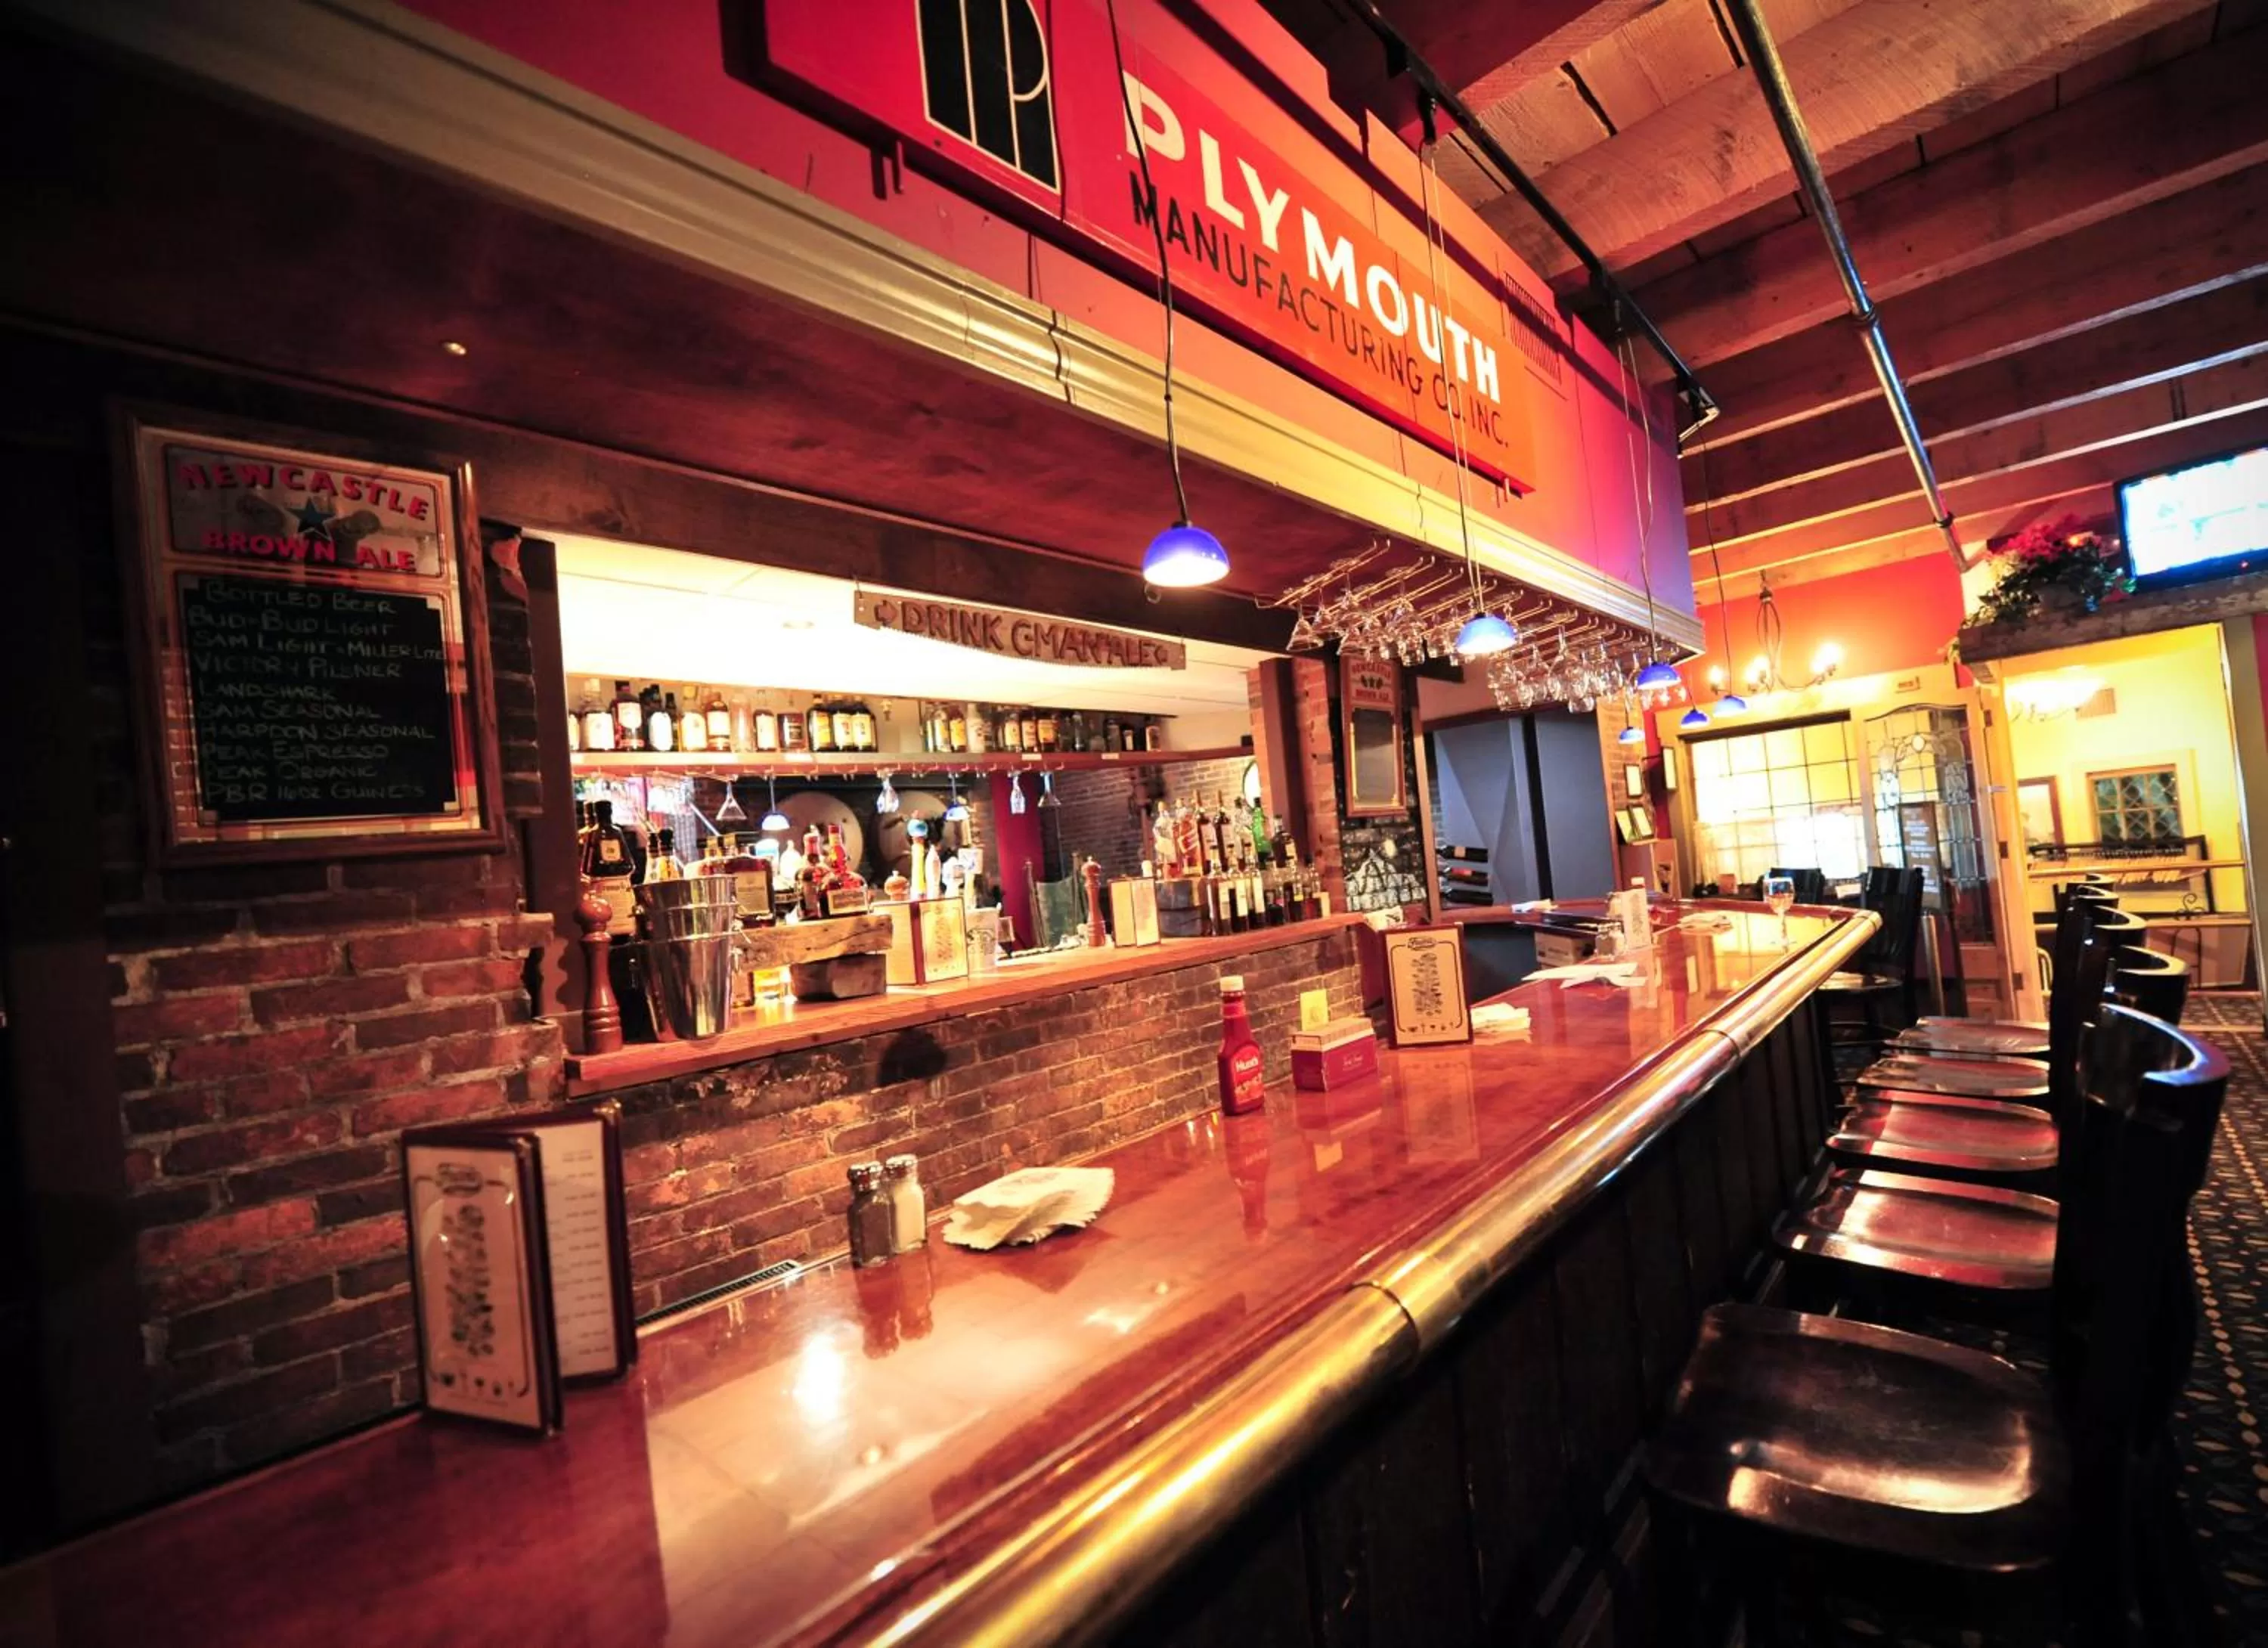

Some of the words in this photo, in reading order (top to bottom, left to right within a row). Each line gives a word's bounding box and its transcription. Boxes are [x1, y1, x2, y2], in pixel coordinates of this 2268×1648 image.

[1122, 70, 1500, 404] PLYMOUTH
[1129, 171, 1424, 395] MANUFACTURING
[1469, 395, 1508, 448] INC.
[177, 464, 429, 522] NEWCASTLE
[201, 529, 337, 562] BROWN
[355, 545, 417, 572] ALE
[900, 600, 1005, 652] DRINK
